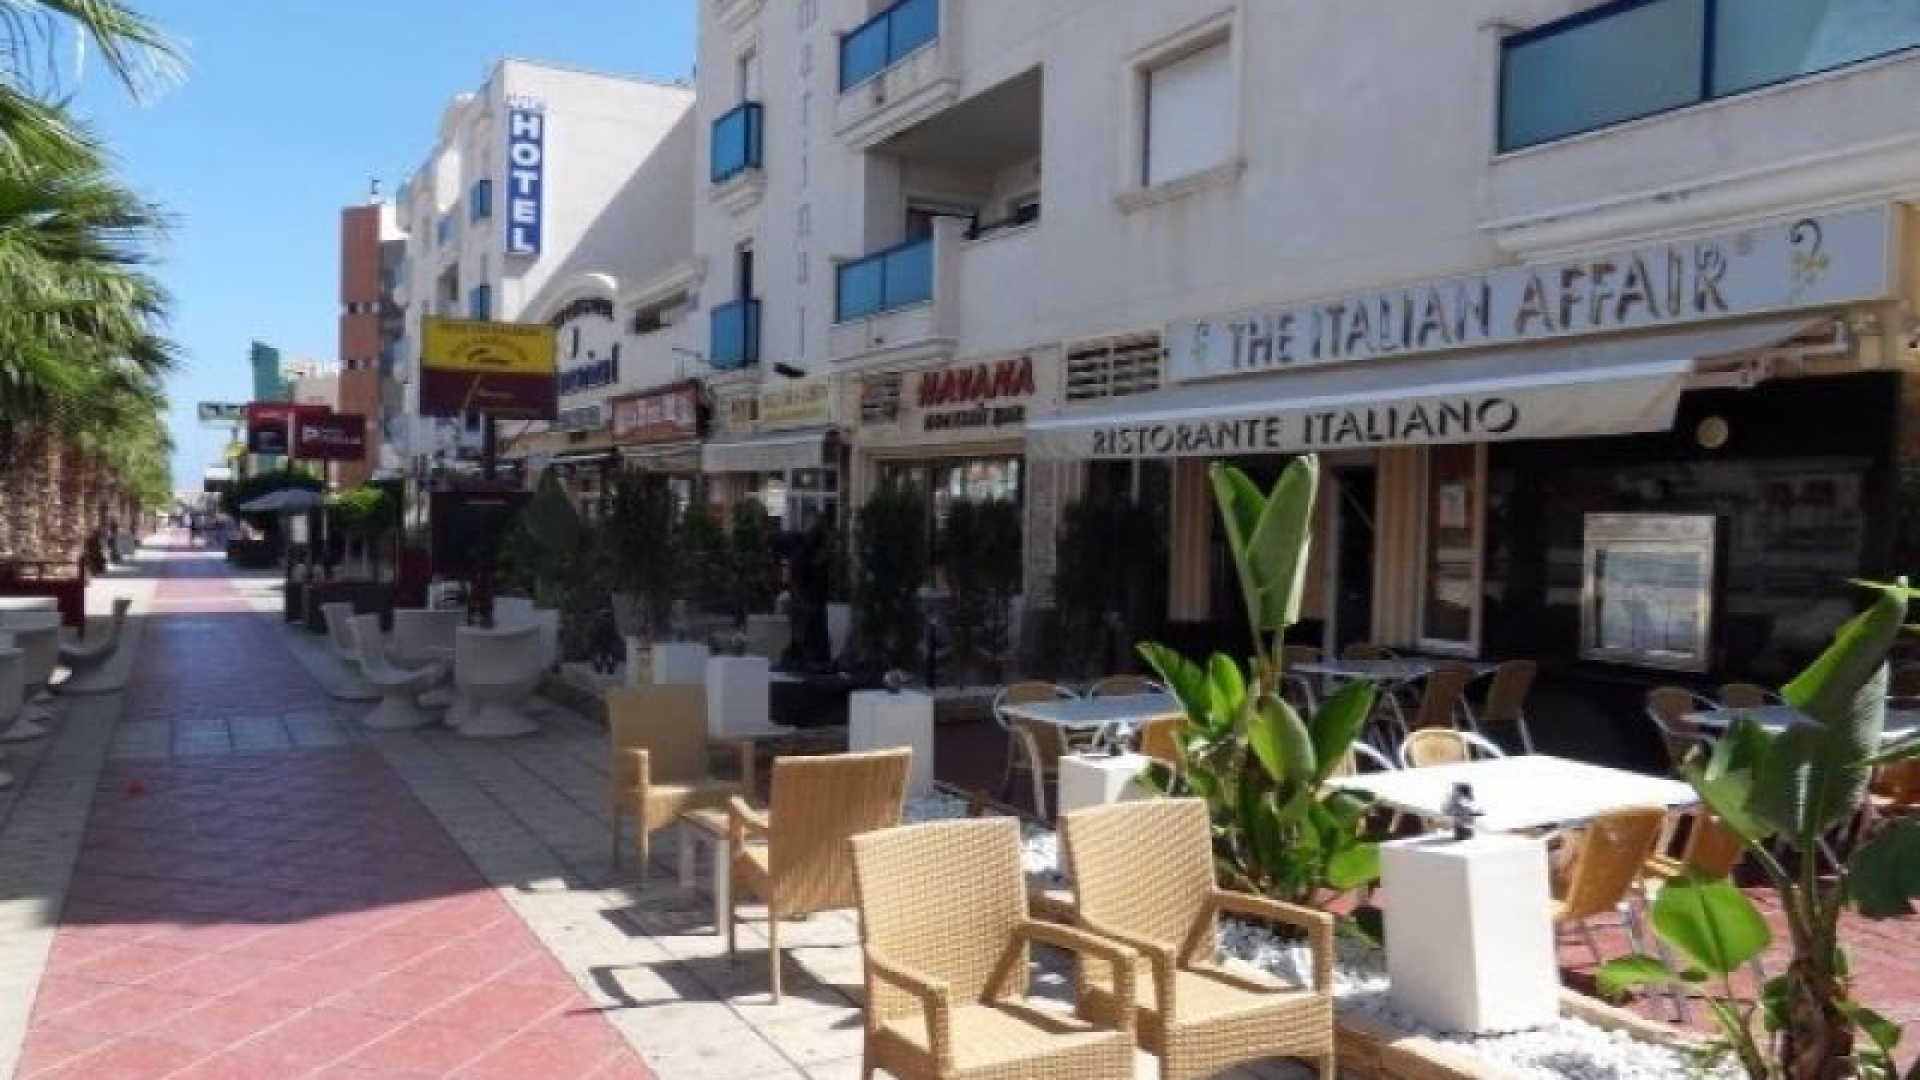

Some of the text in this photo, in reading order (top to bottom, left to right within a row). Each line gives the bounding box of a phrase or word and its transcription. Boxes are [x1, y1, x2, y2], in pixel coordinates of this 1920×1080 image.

[512, 114, 541, 252] HOTEL
[1228, 241, 1728, 370] THE ITALIAN AFFAIR
[917, 356, 1036, 407] HAVANA
[1092, 397, 1519, 455] RISTORANTE ITALIANO
